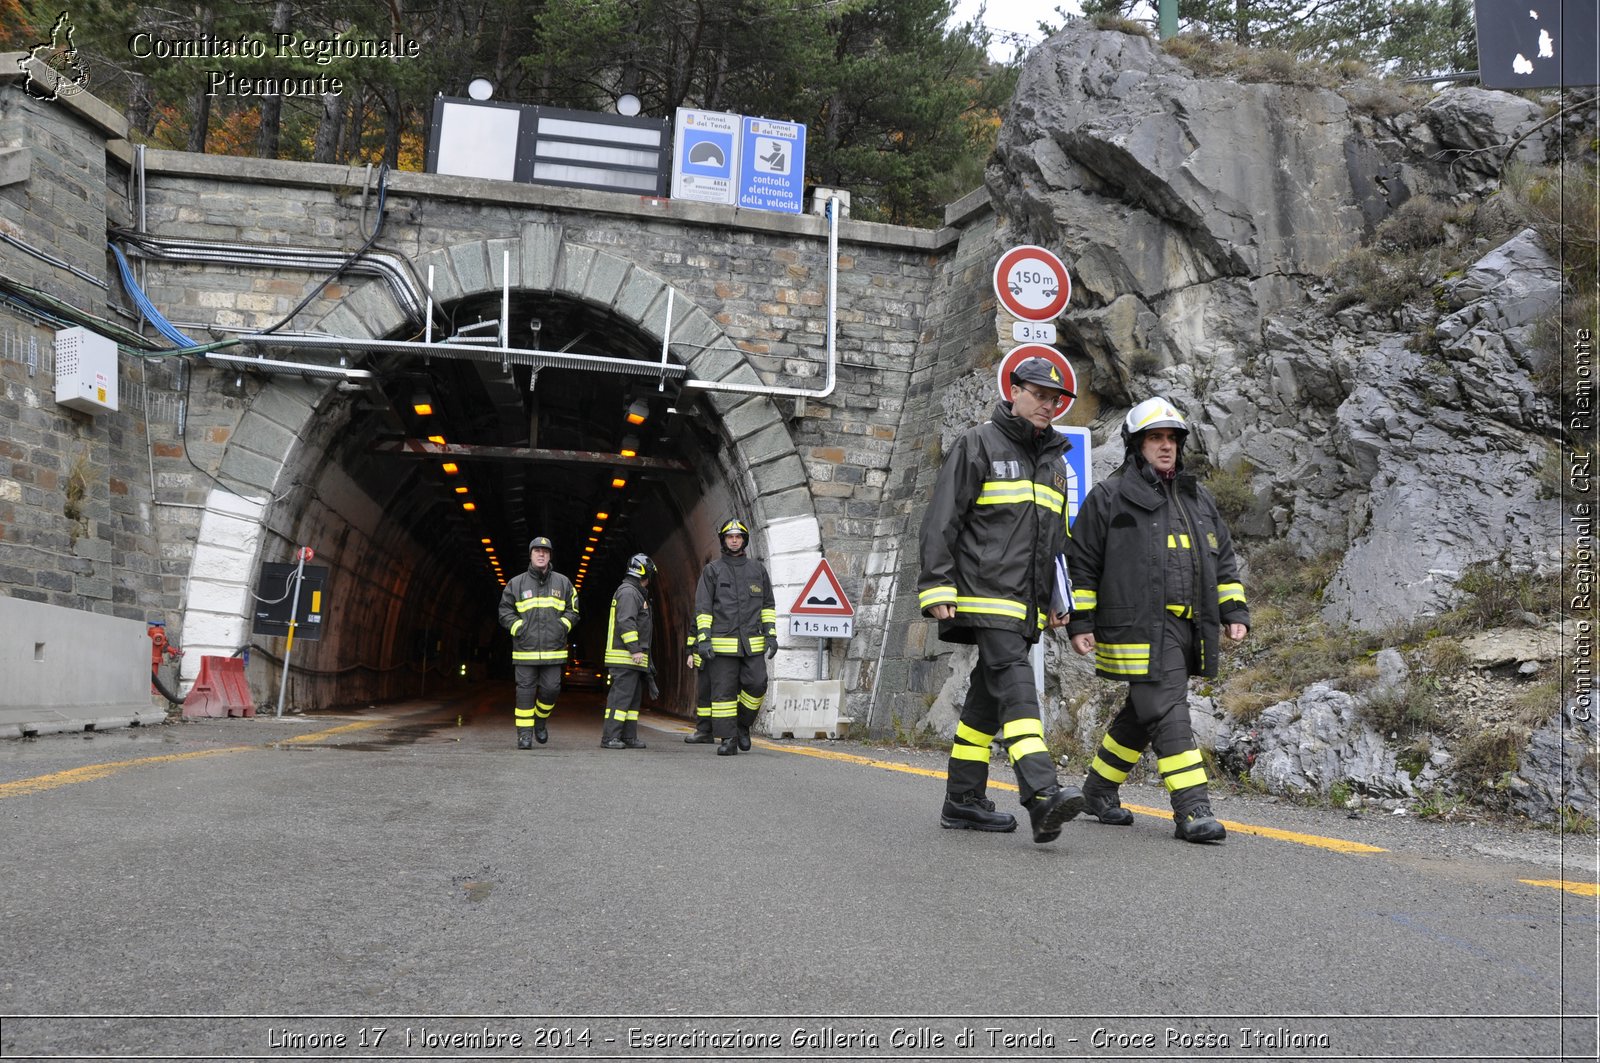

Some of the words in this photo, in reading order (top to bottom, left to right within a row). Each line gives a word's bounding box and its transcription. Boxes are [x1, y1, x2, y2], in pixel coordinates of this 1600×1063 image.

[703, 115, 726, 123] Tunnel
[711, 122, 731, 130] Tenda
[769, 122, 791, 132] Tunnel
[776, 130, 796, 138] Tenda
[753, 176, 790, 188] controllo
[748, 184, 793, 199] elettronico
[741, 194, 763, 205] della
[766, 198, 799, 210] velocità
[1015, 271, 1041, 284] 150
[1043, 276, 1053, 285] m
[823, 624, 839, 632] km
